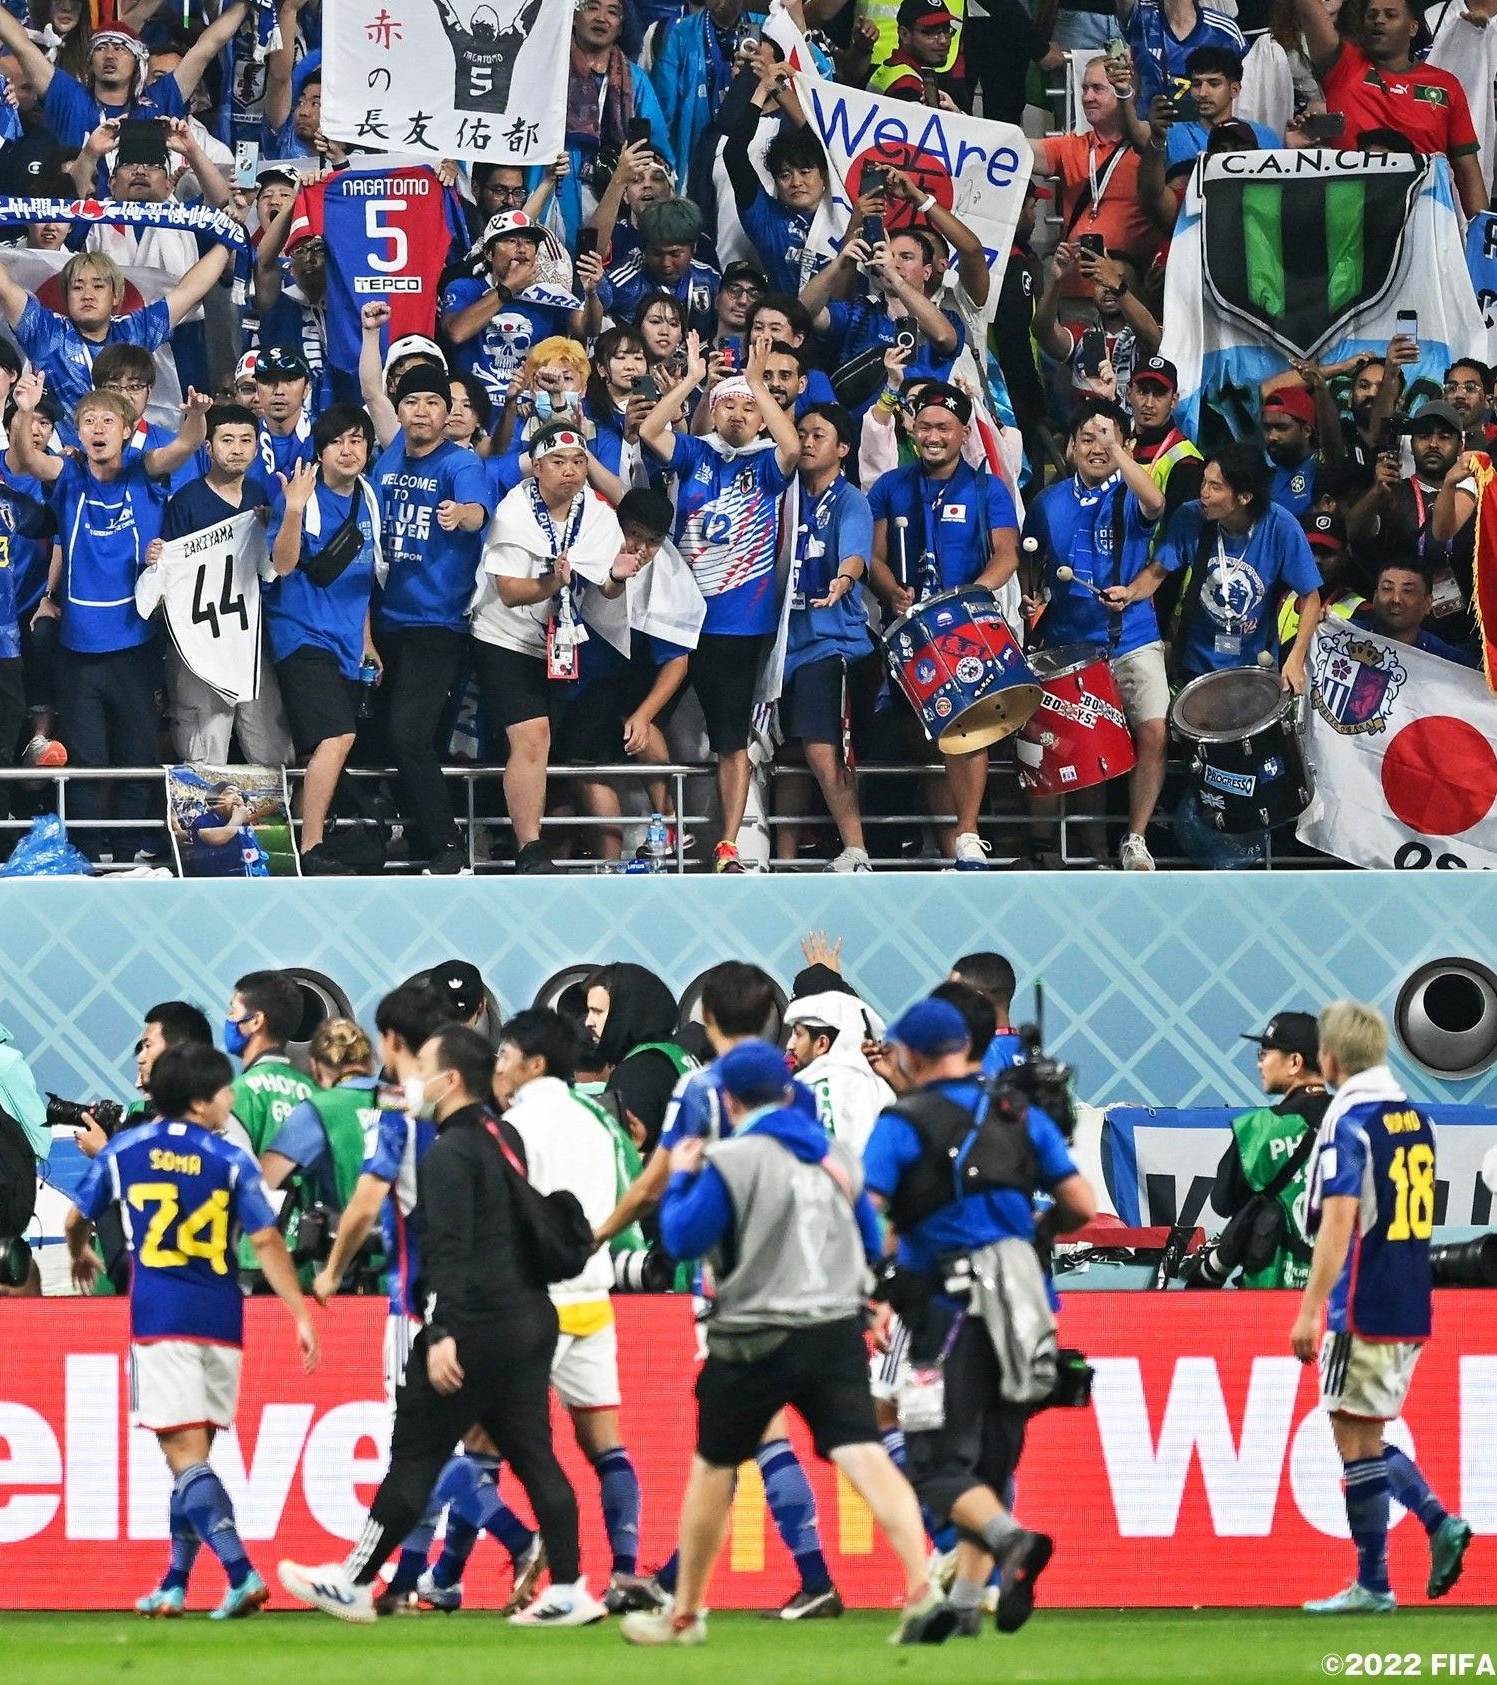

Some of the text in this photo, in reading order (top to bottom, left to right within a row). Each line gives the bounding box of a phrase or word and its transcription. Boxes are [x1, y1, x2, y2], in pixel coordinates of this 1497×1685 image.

[365, 9, 402, 50] 赤
[367, 67, 391, 91] の
[470, 67, 493, 97] 5
[355, 108, 540, 158] 長友佑都
[342, 178, 429, 196] NAGATOMO
[365, 200, 408, 273] 5
[357, 279, 419, 292] TEPCO
[381, 473, 438, 492] WELCOME
[394, 489, 409, 500] TO
[385, 501, 433, 526] LUE
[381, 521, 430, 540] EAVEN
[192, 554, 249, 638] 44
[1207, 767, 1254, 795] PROGRESSO
[149, 1149, 201, 1176] SOMA
[1386, 1143, 1434, 1241] 18
[128, 1182, 229, 1275] 24
